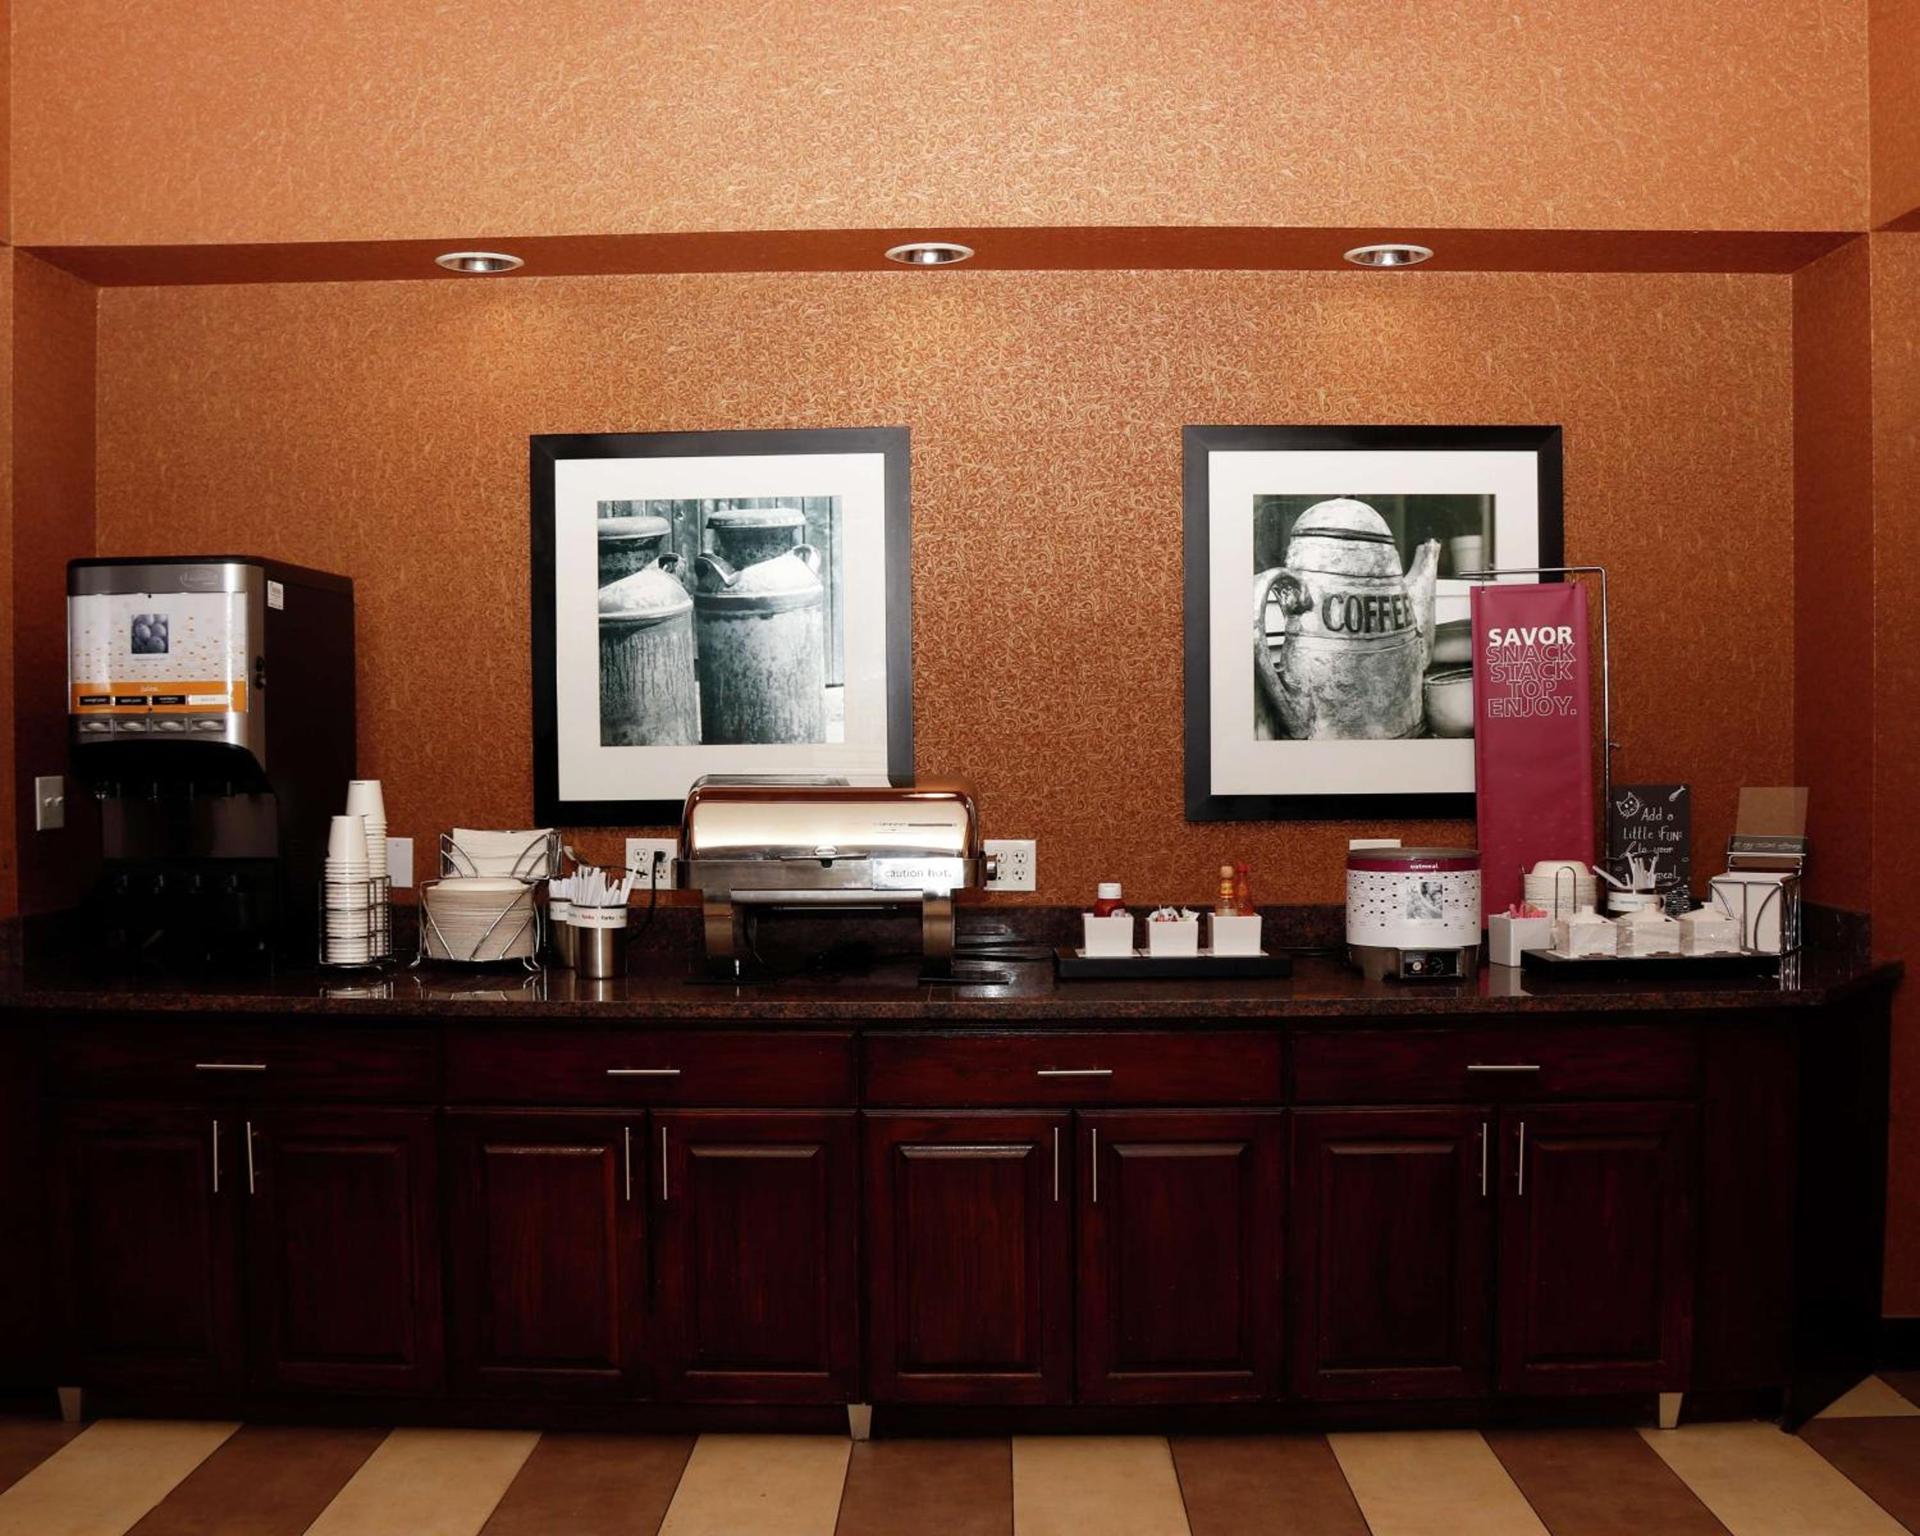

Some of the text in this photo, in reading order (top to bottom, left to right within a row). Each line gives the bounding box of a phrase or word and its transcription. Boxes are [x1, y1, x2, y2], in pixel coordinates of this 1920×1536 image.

[1321, 591, 1413, 634] COFFEE
[1488, 626, 1573, 648] SAVOR
[1486, 642, 1577, 664] SNACK
[1490, 660, 1575, 682] STACK
[1506, 678, 1557, 700] TOP
[1488, 695, 1577, 718] ENJOY.
[1641, 807, 1662, 821] Add
[1623, 825, 1654, 840] Little
[885, 868, 924, 878] caution
[1410, 862, 1438, 870] oatmeal
